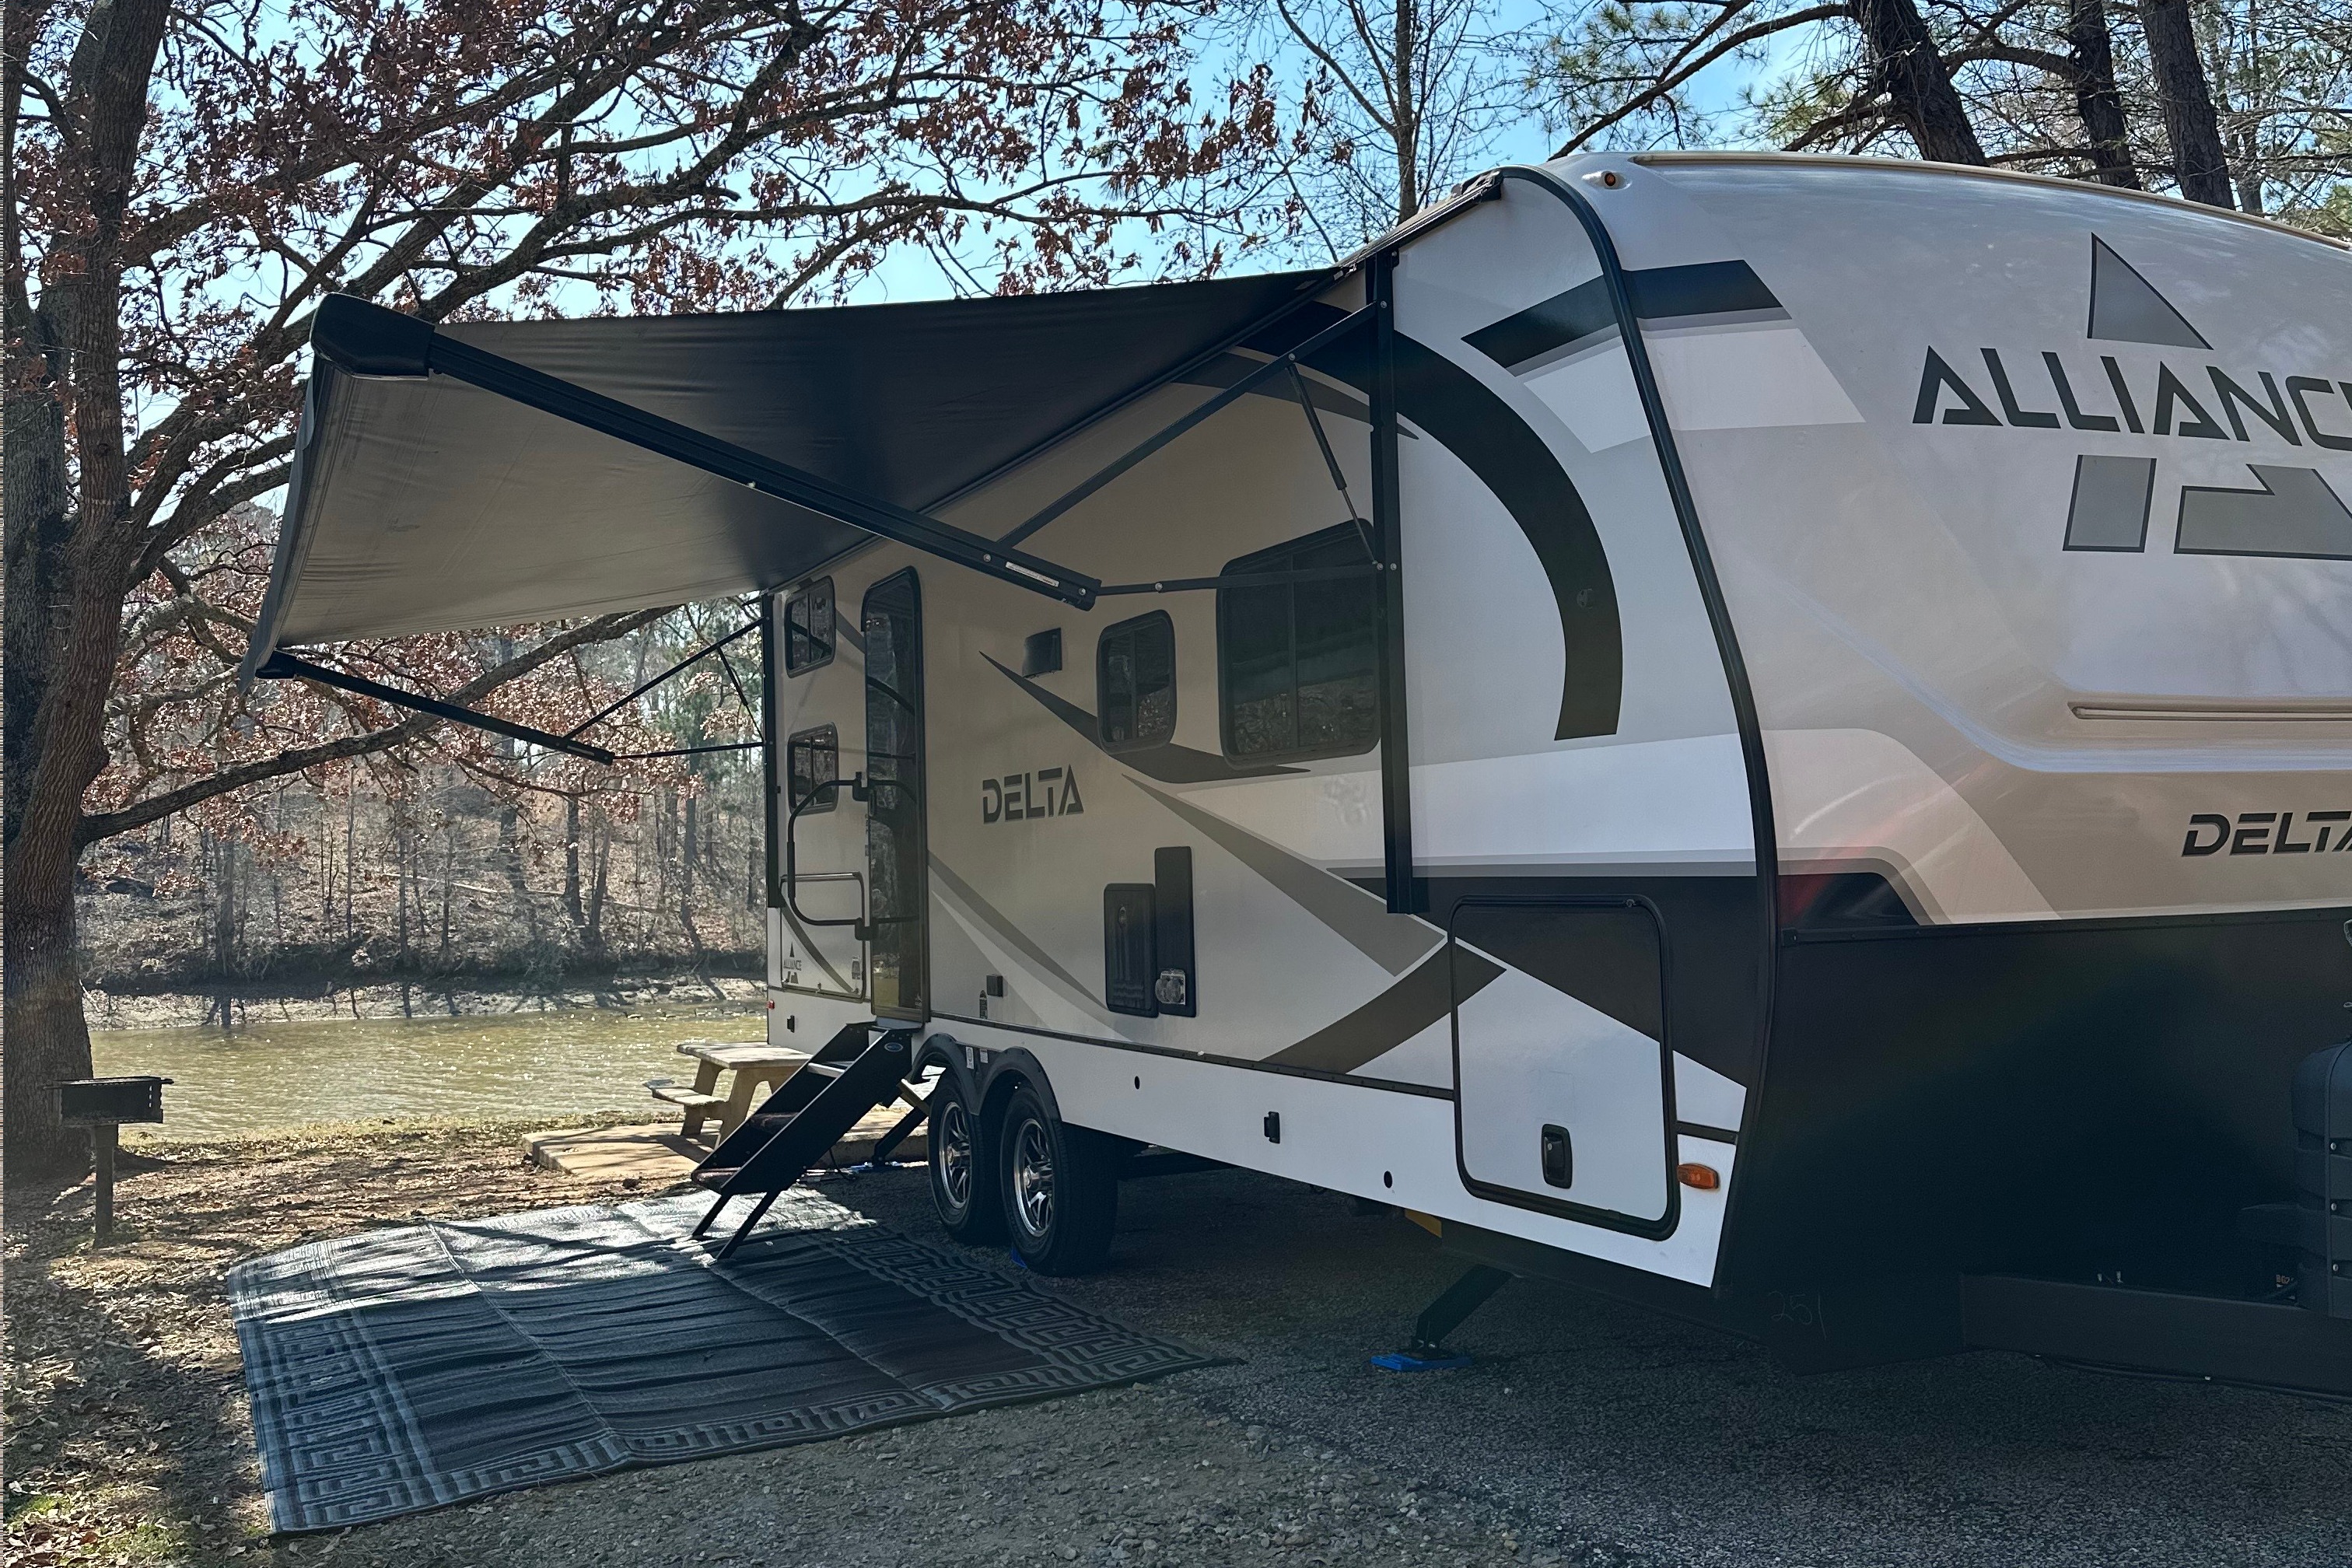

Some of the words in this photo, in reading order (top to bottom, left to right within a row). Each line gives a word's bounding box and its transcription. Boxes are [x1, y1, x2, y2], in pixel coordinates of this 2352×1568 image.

[1913, 345, 2352, 452] ALLIANC
[982, 764, 1083, 824] DELTA
[1766, 1289, 1827, 1340] 251
